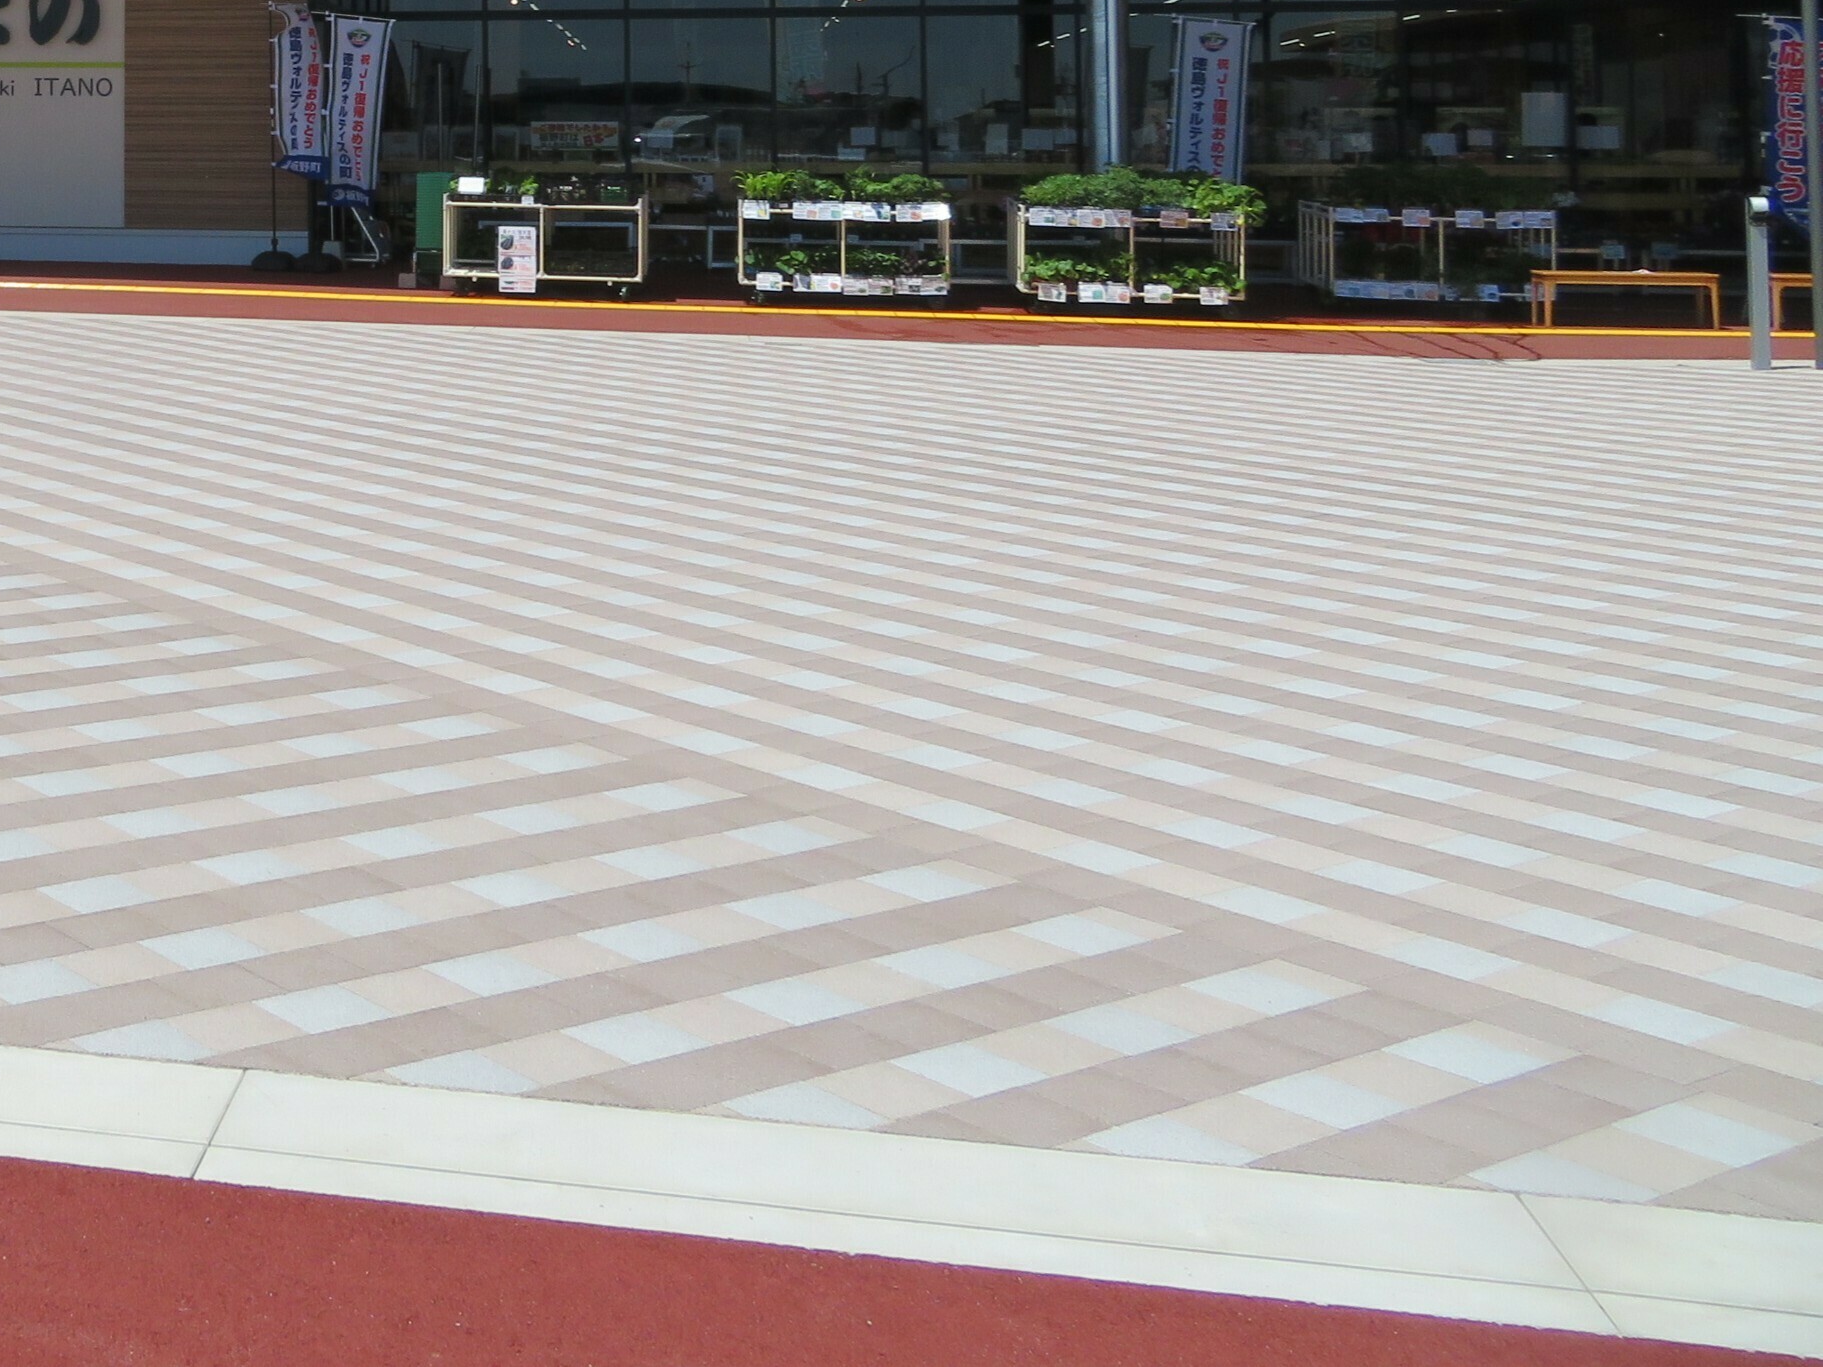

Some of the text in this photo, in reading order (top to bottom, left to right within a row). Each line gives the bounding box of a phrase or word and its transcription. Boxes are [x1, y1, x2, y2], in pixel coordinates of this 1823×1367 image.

[34, 77, 114, 98] ITANO
[1776, 40, 1806, 203] 応援に行こう
